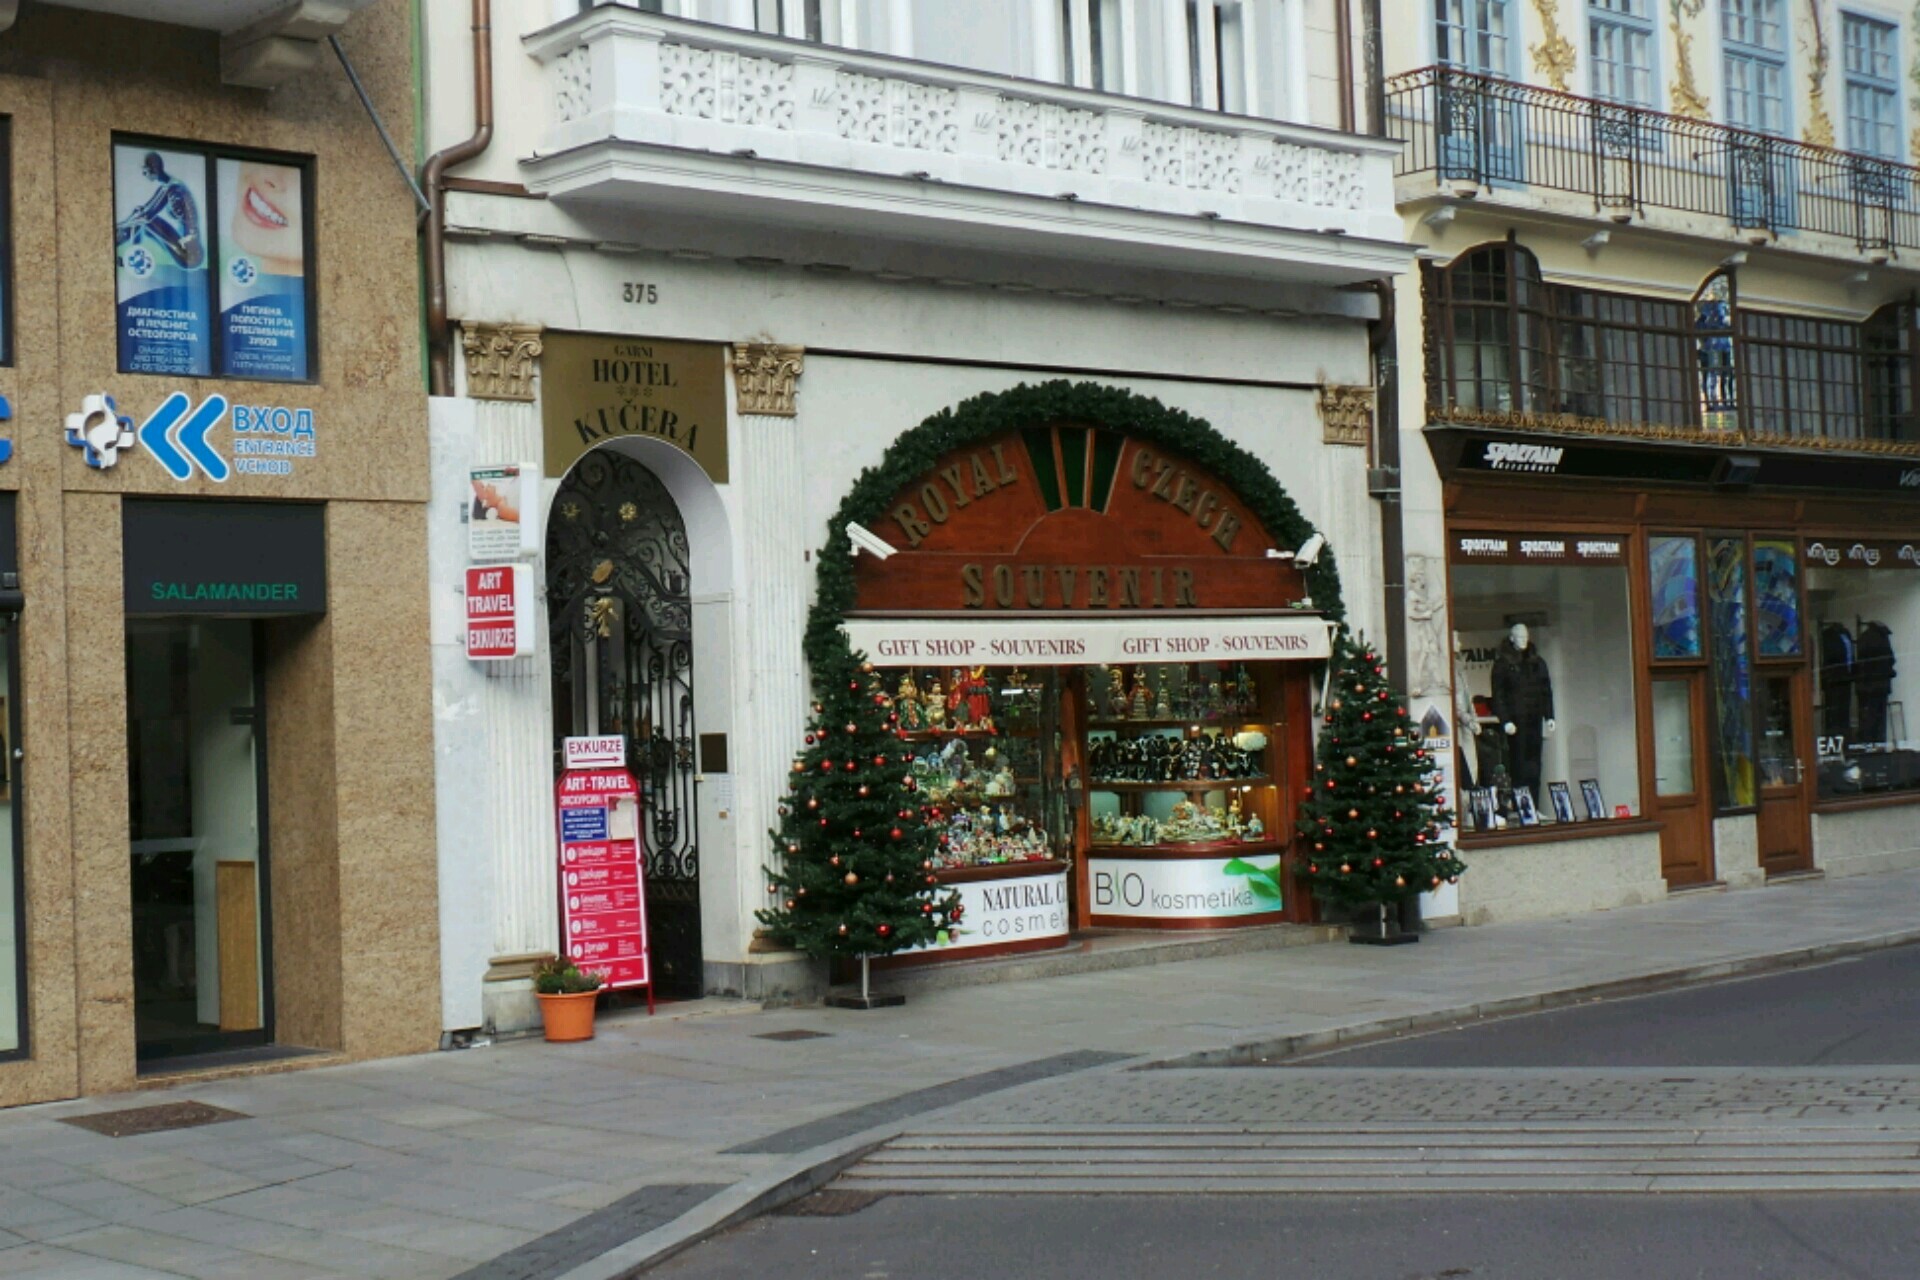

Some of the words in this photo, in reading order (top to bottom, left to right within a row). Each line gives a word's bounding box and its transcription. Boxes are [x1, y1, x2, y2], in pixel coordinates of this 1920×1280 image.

[623, 282, 658, 304] 375
[614, 344, 653, 358] GARNI
[593, 359, 679, 388] HOTEL
[233, 405, 315, 441] ВХОД
[574, 398, 699, 452] KUČERA
[234, 438, 316, 457] ENTRANCE
[234, 457, 294, 475] VCHOD
[891, 443, 1018, 548] ROYAL
[1132, 448, 1241, 554] CZECH
[151, 582, 298, 600] SALAMANDER
[478, 571, 502, 590] ART
[961, 562, 1198, 608] SOUVENIR
[467, 595, 515, 614] TRAVEL
[469, 627, 515, 650] EXKURZE
[878, 639, 921, 657] GIFT
[925, 638, 976, 657] SHOP
[989, 638, 1086, 656] SOUVENIRS
[1122, 637, 1162, 654] GIFT
[1166, 636, 1210, 653] SHOP
[1222, 633, 1309, 651] SOUVENIRS
[567, 740, 622, 755] EXKURZE
[1817, 735, 1844, 755] EA7
[982, 881, 1053, 912] NATURAL
[1096, 866, 1144, 908] BIO
[1151, 888, 1254, 910] kosmetika
